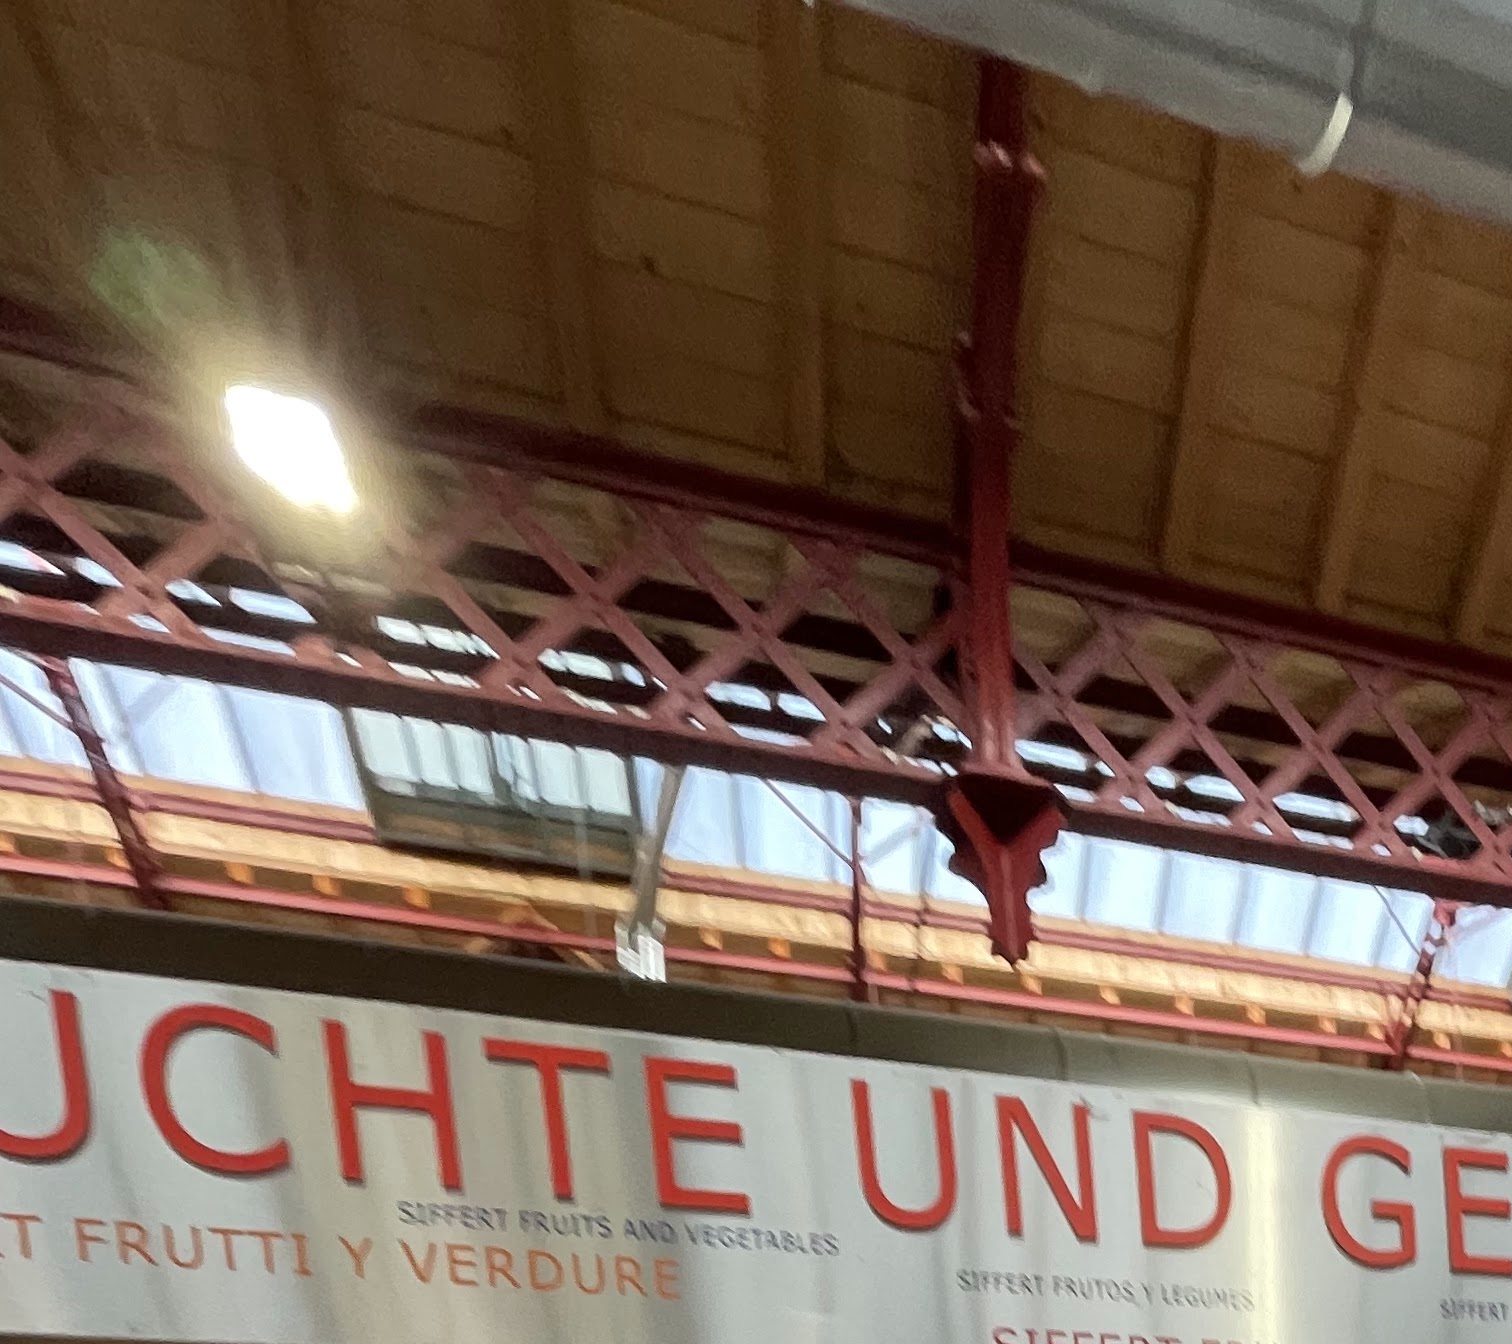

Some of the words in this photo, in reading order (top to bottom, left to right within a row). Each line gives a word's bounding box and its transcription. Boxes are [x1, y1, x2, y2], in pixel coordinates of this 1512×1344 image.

[848, 1078, 1234, 1252] UND
[72, 1215, 314, 1277] FRUTTI
[337, 1233, 374, 1279] Y
[396, 1237, 684, 1301] VERDURE
[397, 1200, 508, 1233] SIFFERT
[518, 1207, 614, 1240] FRUITS
[623, 1217, 681, 1246] AND
[682, 1222, 840, 1258] VEGETABLES
[956, 1268, 1044, 1298] SIFFERT
[1440, 1297, 1508, 1323] SIFFERT
